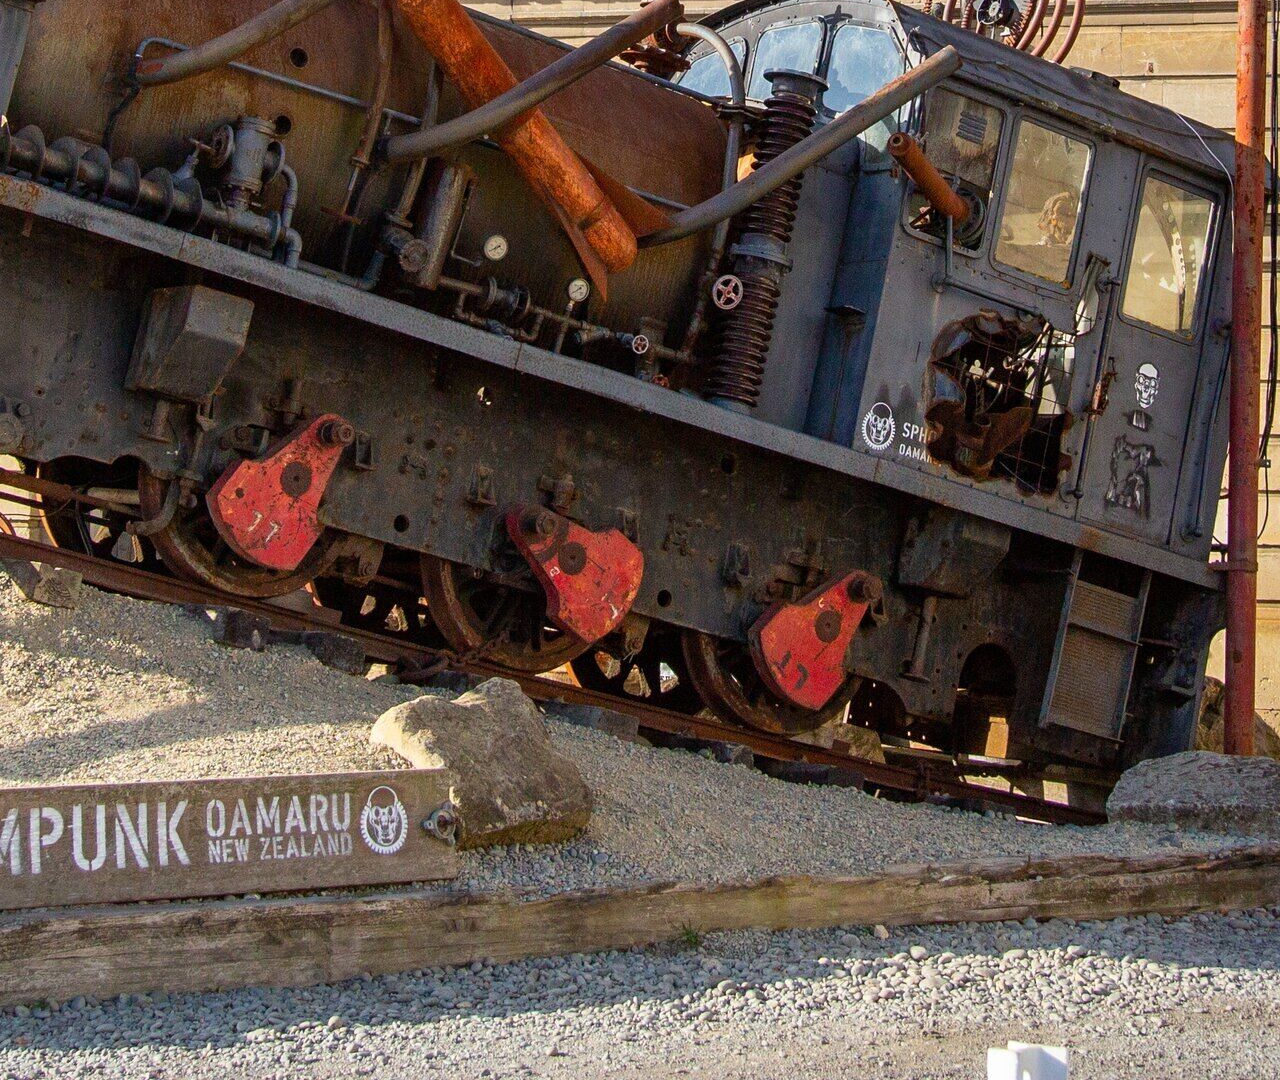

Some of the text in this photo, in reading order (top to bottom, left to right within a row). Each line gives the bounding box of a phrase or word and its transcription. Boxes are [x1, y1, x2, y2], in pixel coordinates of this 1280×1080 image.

[206, 792, 351, 838] OAMARU
[208, 832, 353, 864] NEW ZEALAND
